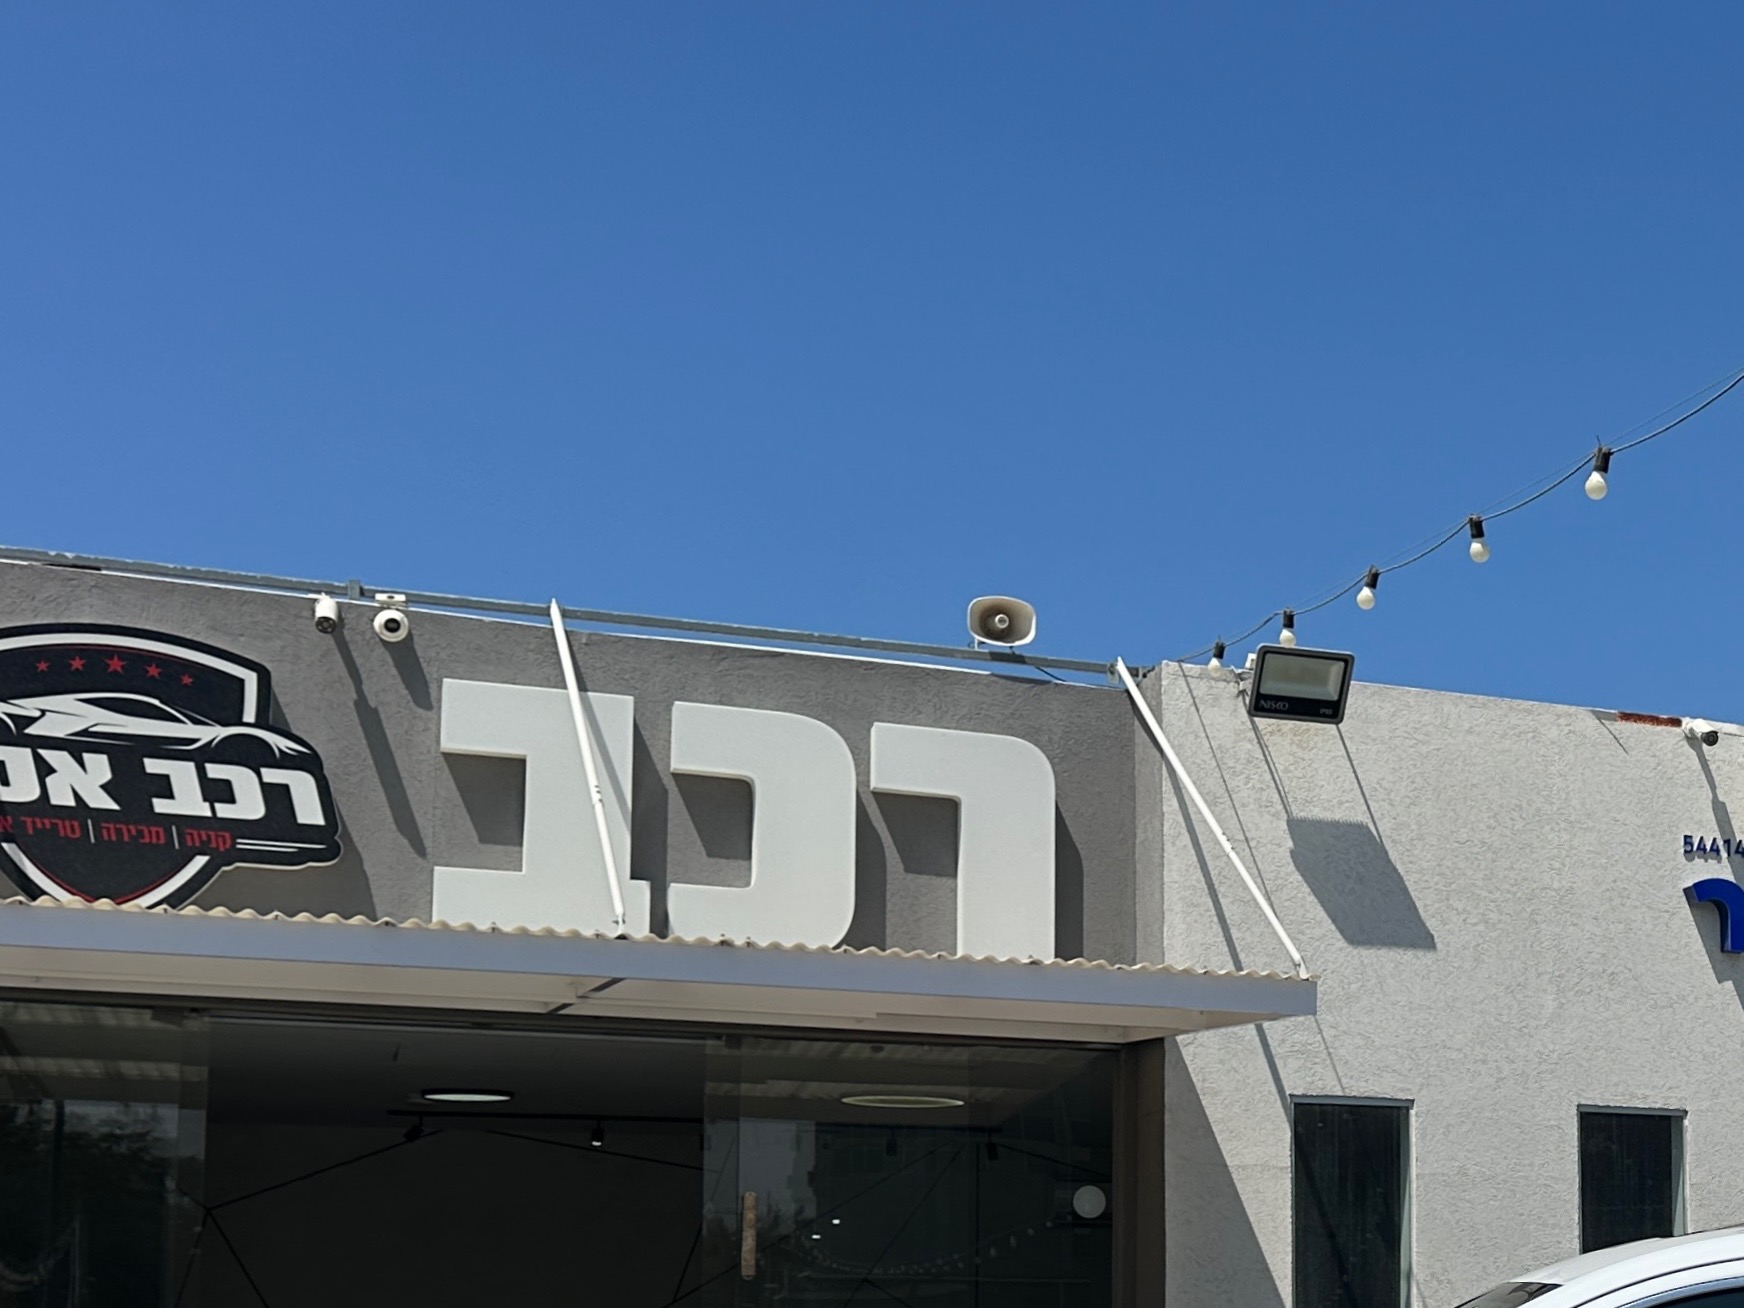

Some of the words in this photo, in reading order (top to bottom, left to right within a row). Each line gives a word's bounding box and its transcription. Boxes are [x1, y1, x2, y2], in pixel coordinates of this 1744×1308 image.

[142, 757, 327, 826] רכב
[20, 816, 82, 839] טרייד
[432, 678, 1056, 961] רכב
[101, 822, 166, 845] מכירה
[184, 828, 232, 851] קניה
